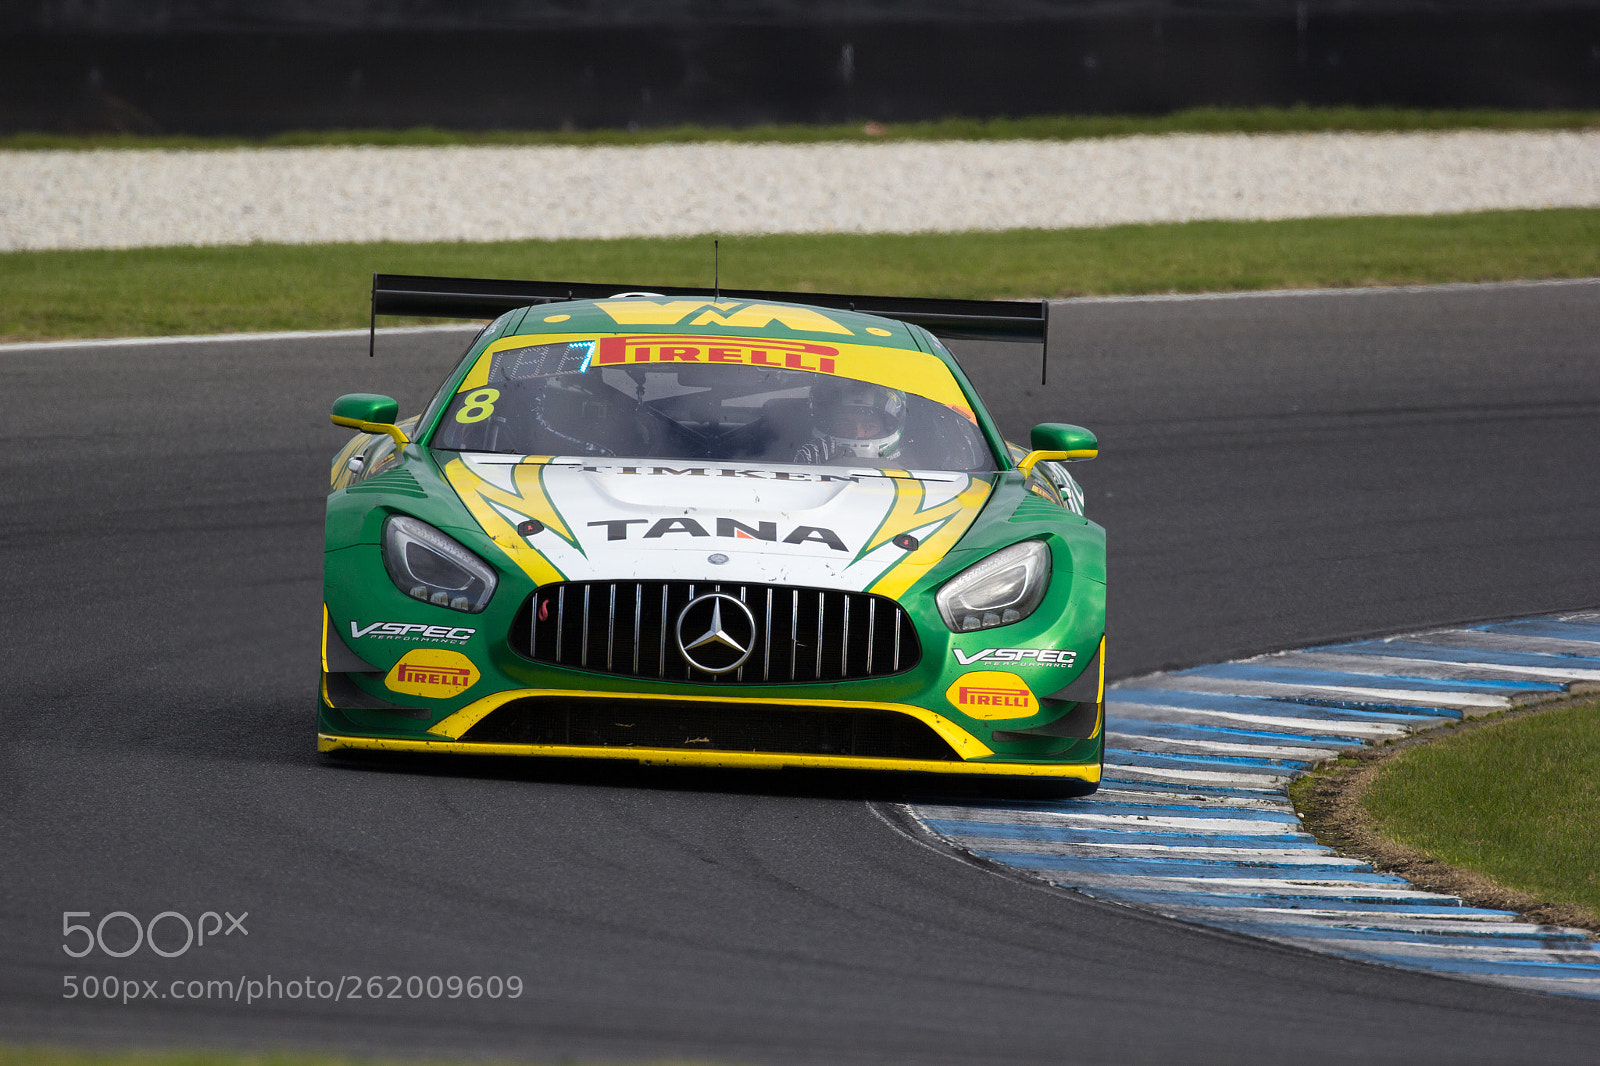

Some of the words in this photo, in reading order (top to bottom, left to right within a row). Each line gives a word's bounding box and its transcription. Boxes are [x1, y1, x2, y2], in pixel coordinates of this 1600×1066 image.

[600, 335, 839, 374] PIRELLI
[455, 388, 500, 424] 8
[587, 517, 850, 552] TANA
[370, 634, 468, 645] PERFORMANCE
[397, 664, 471, 687] PIRELLI
[959, 686, 1030, 708] PIRELLI
